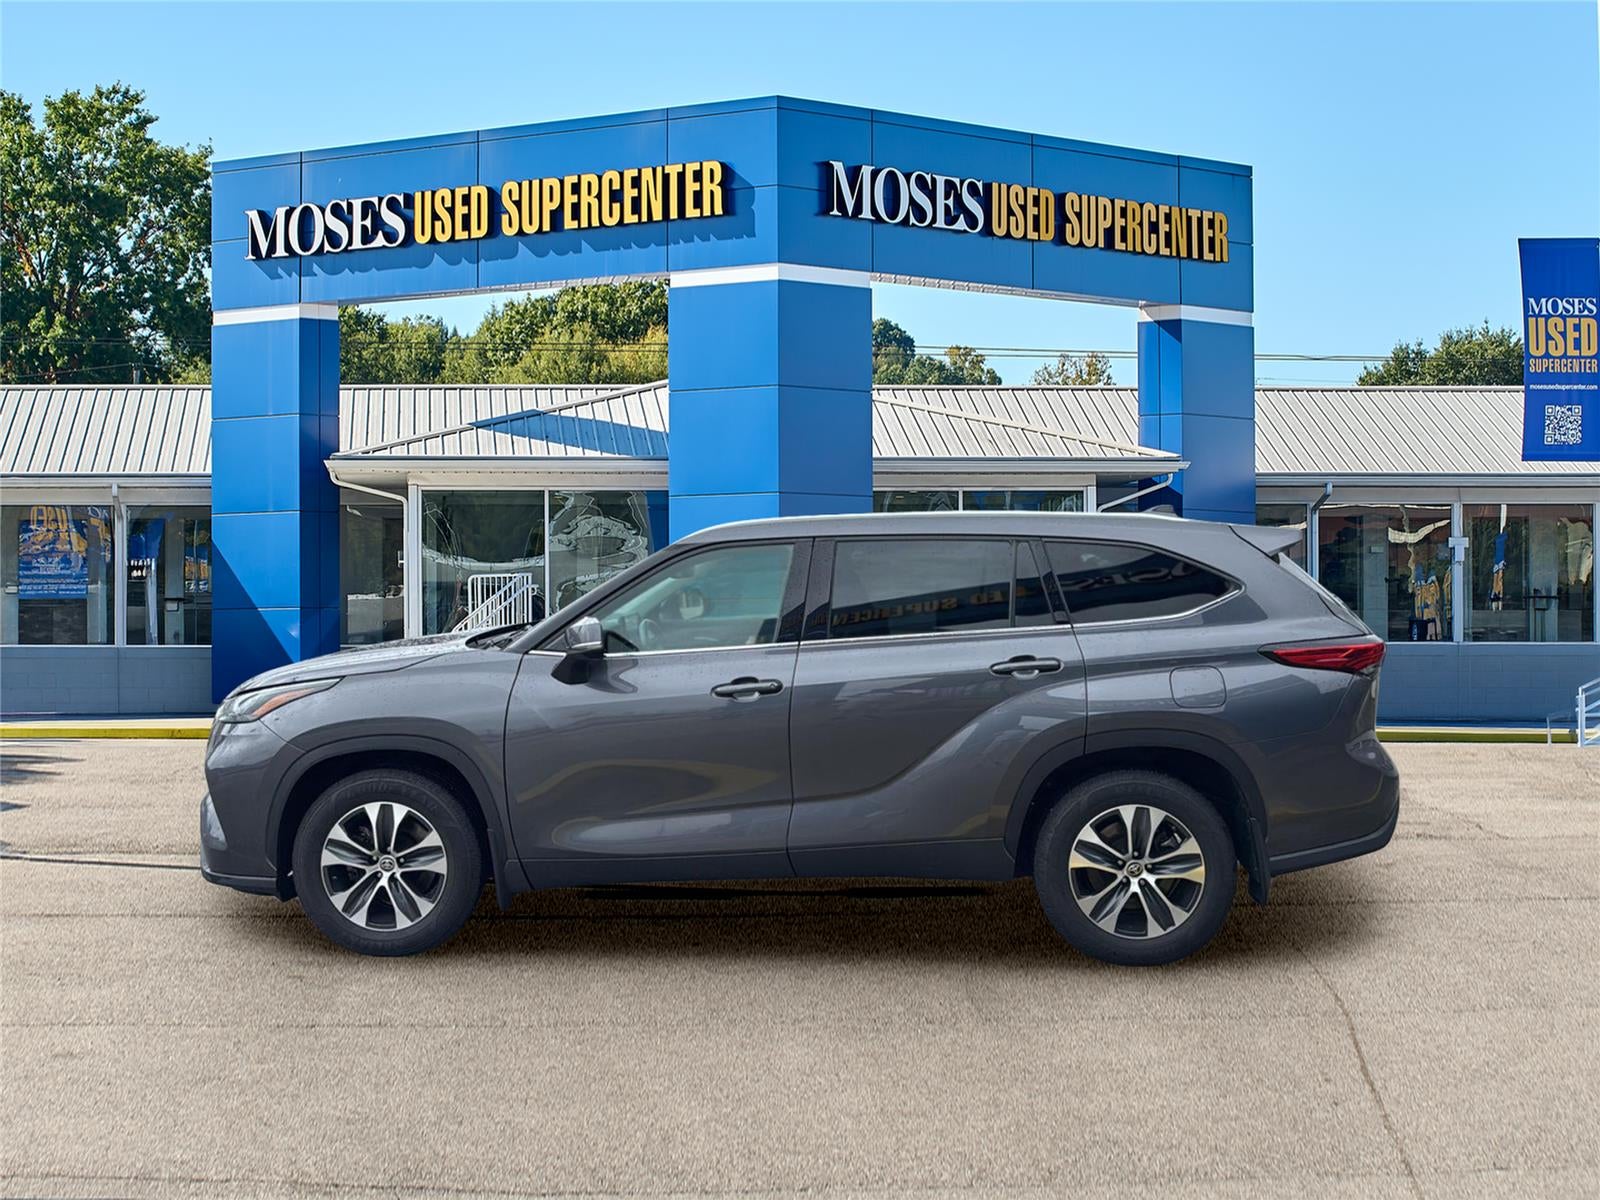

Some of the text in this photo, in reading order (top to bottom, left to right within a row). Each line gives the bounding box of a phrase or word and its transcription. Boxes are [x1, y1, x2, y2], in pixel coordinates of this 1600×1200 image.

[244, 160, 723, 260] MOSES USED SUPERCENTER
[829, 160, 1229, 262] MOSES USED SUPERCENTER
[1528, 298, 1597, 315] MOSES
[1528, 318, 1598, 356] USED
[1530, 359, 1598, 373] SUPERCENTER
